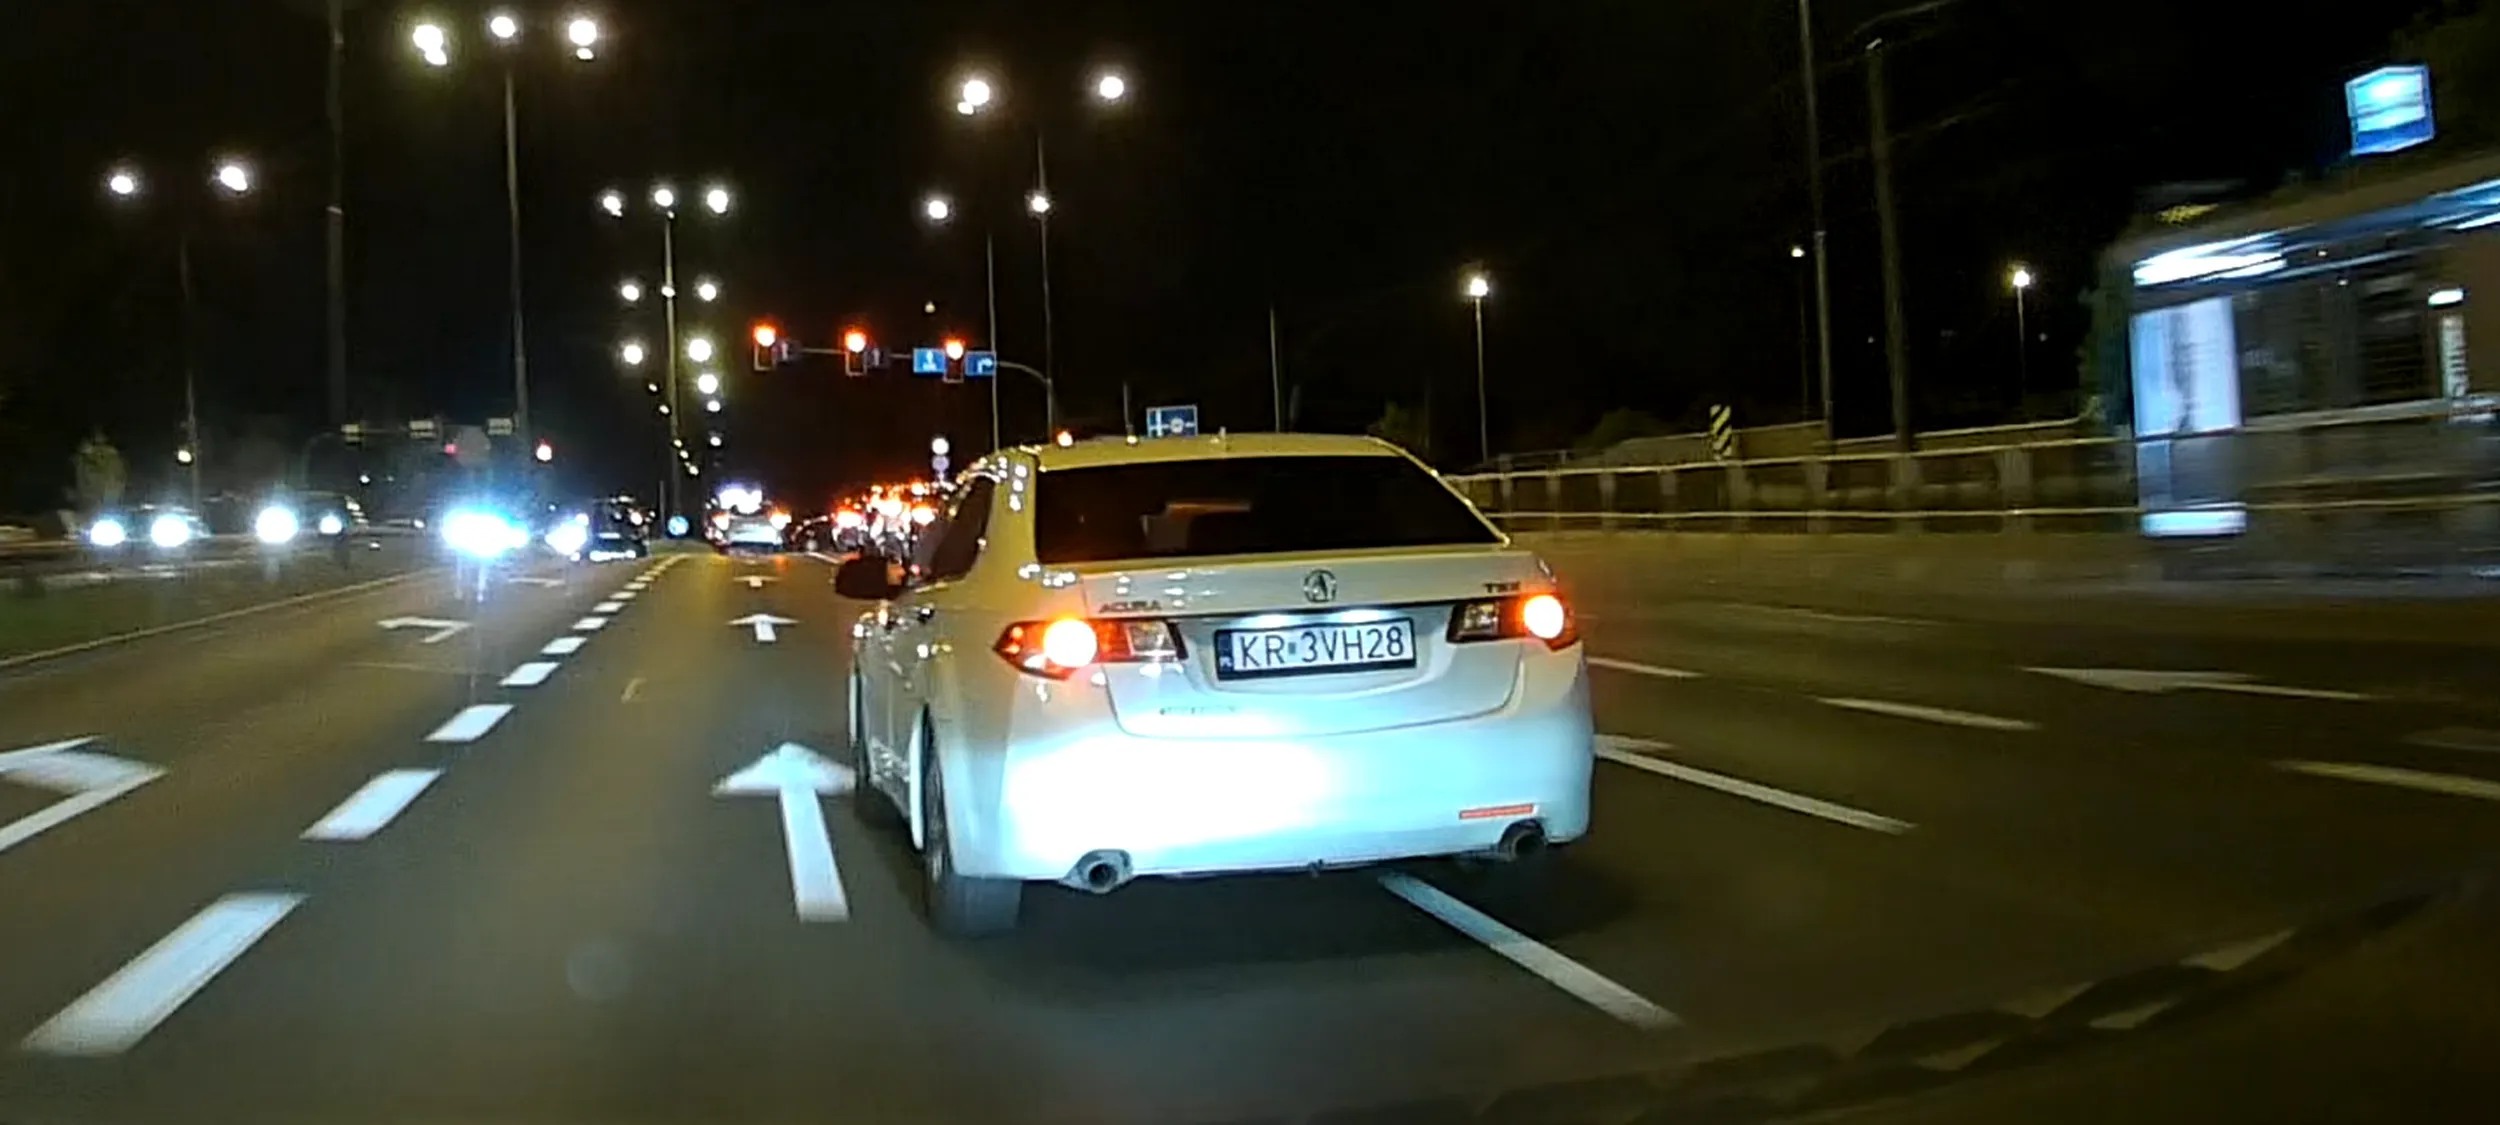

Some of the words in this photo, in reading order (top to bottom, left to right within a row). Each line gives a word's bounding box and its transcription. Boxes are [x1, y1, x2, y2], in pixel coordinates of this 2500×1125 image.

[1099, 600, 1162, 614] ACURA
[1239, 634, 1286, 668] KR
[1300, 625, 1405, 664] 3VH28
